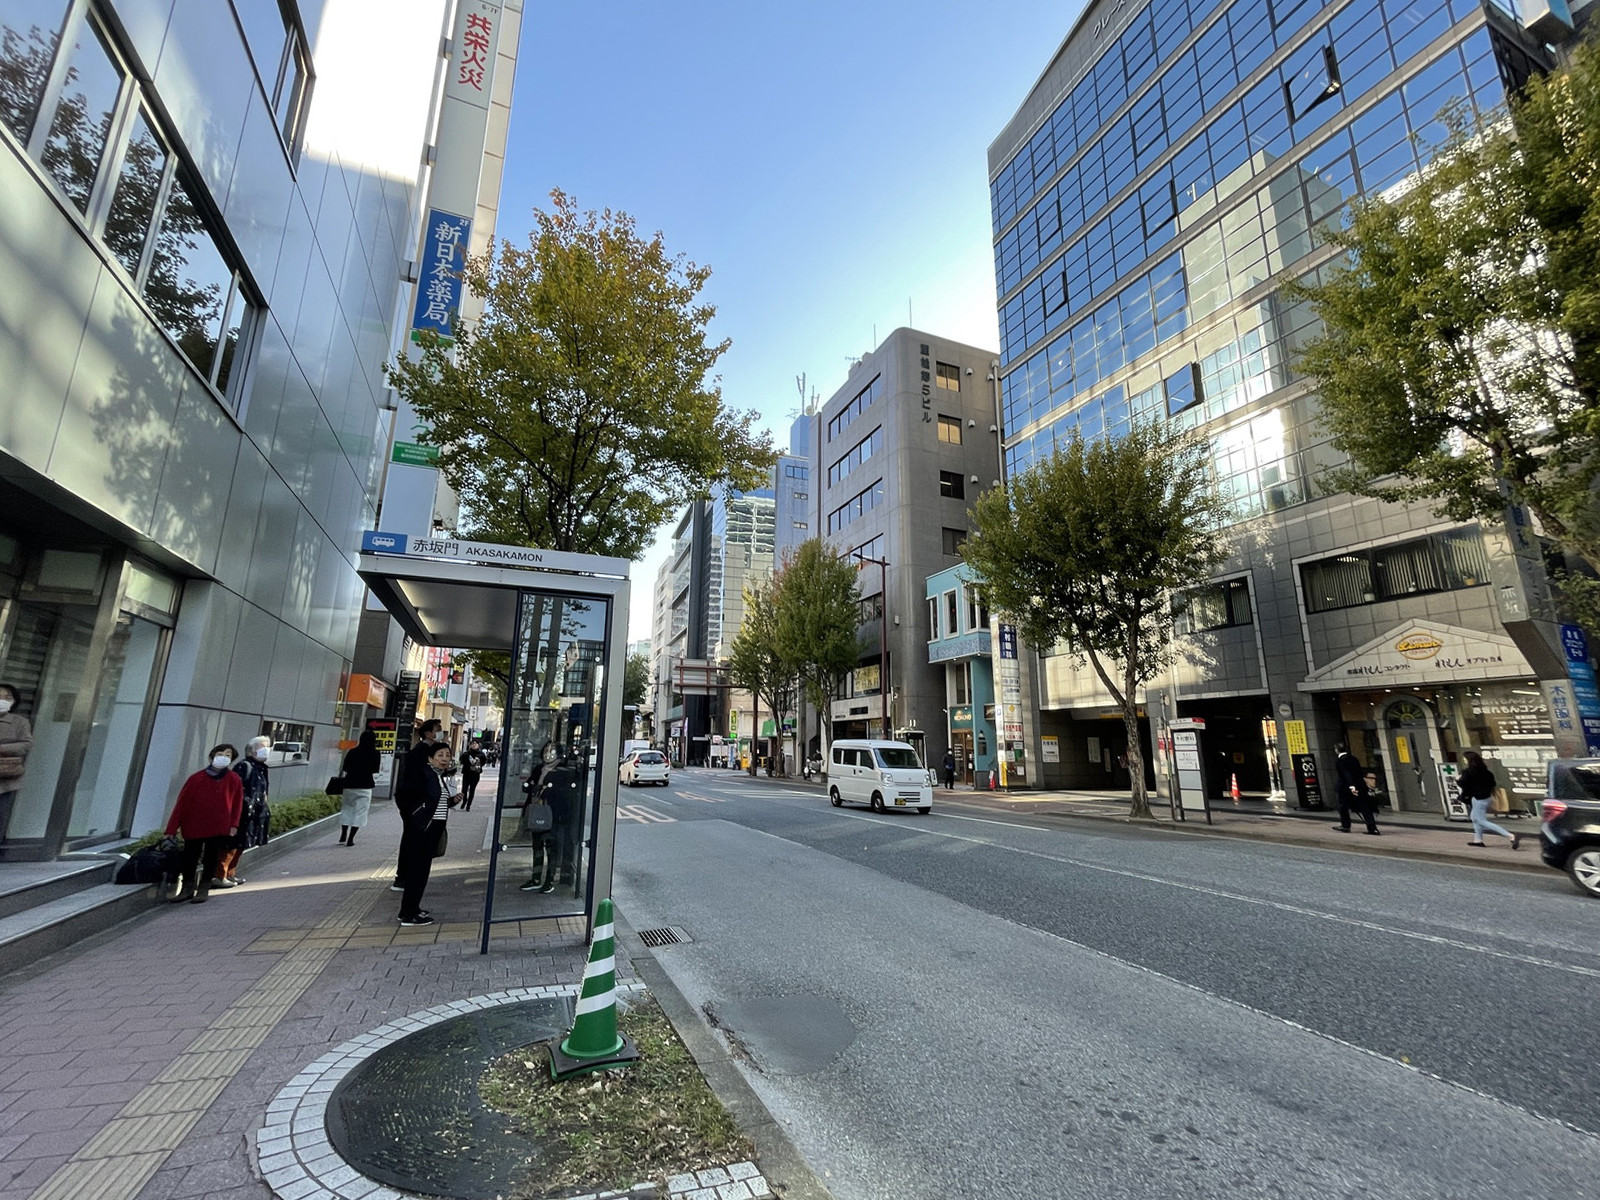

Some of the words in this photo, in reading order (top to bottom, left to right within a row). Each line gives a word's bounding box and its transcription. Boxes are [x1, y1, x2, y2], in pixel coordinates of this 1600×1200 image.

[458, 13, 492, 91] 共栄火災
[459, 217, 470, 228] 2F
[421, 221, 463, 326] 新日本薬局
[413, 538, 459, 556] 赤坂門
[465, 546, 543, 563] AKASAKAMON
